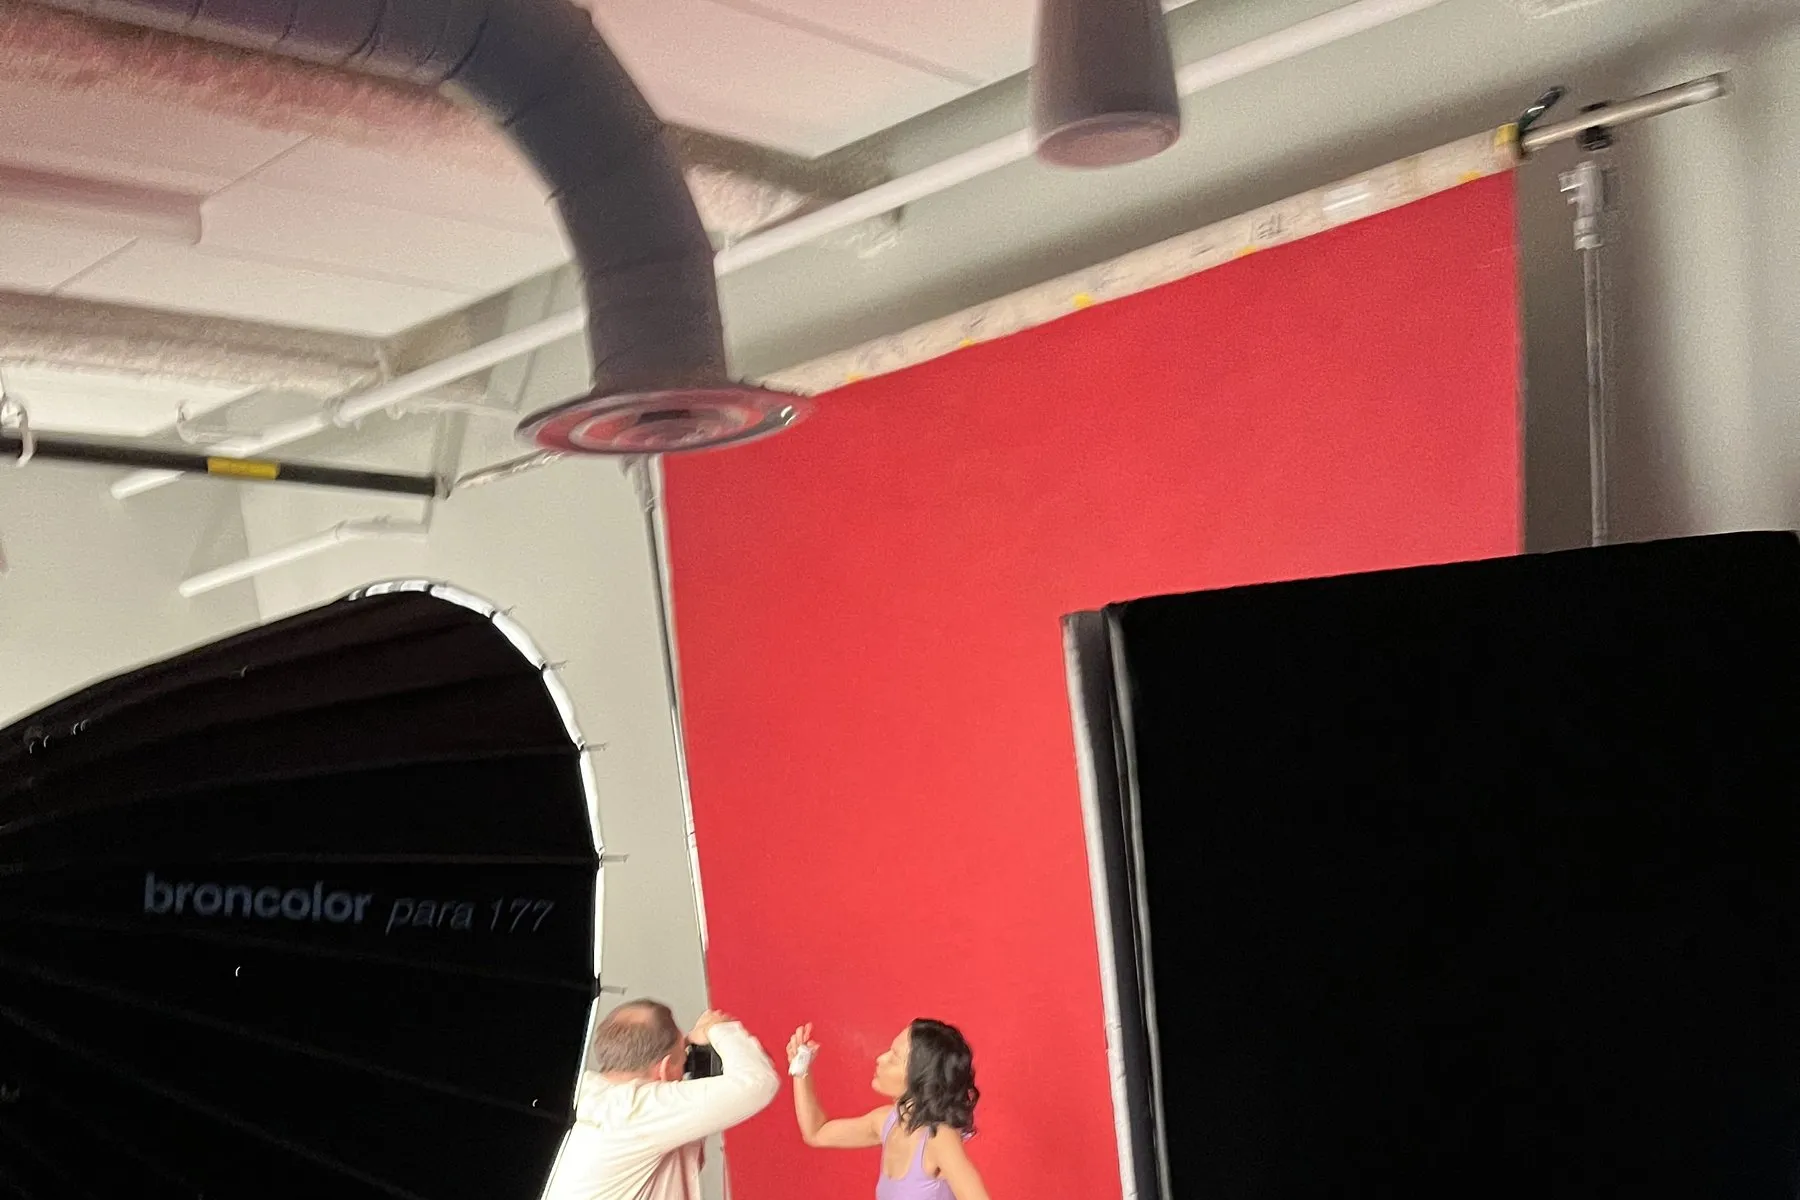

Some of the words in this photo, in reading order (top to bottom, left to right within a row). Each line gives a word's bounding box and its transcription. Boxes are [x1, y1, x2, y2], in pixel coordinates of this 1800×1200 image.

[143, 871, 373, 922] broncolor
[385, 899, 474, 935] para
[490, 898, 555, 932] 177
